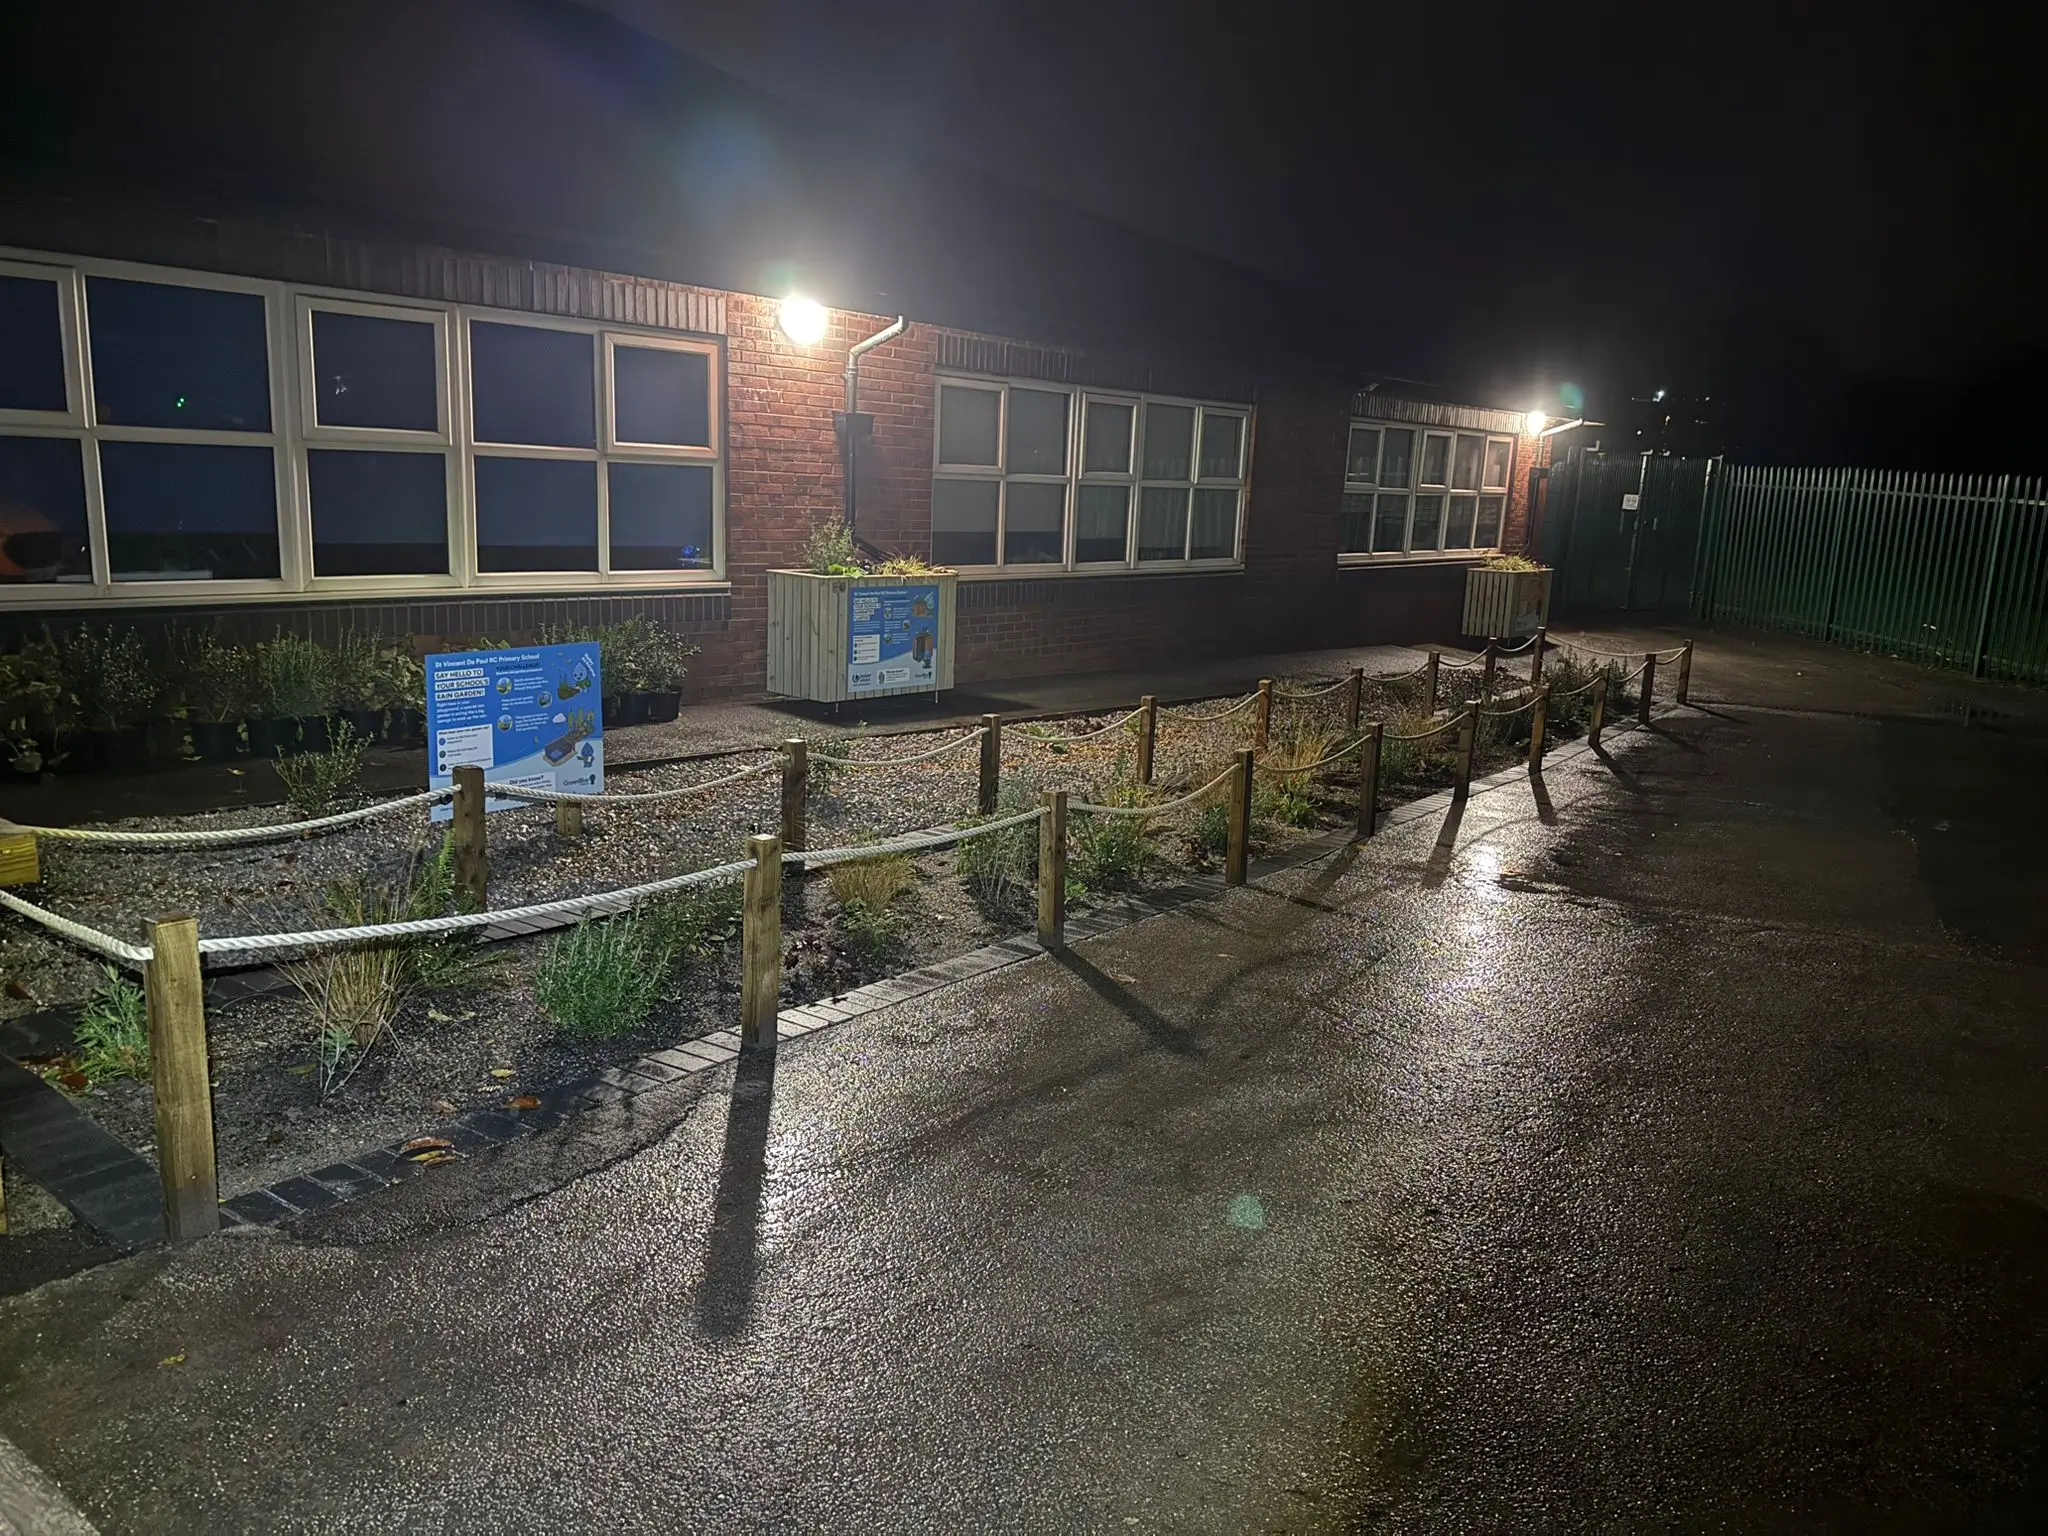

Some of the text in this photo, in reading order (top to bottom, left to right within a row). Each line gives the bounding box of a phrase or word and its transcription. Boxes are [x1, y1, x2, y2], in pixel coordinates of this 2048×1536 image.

[476, 657, 488, 665] Paul
[499, 655, 520, 663] Primary
[521, 653, 540, 661] School
[436, 679, 489, 690] YOUR SCHOOL'S
[437, 690, 485, 700] RAIN GARDEN!
